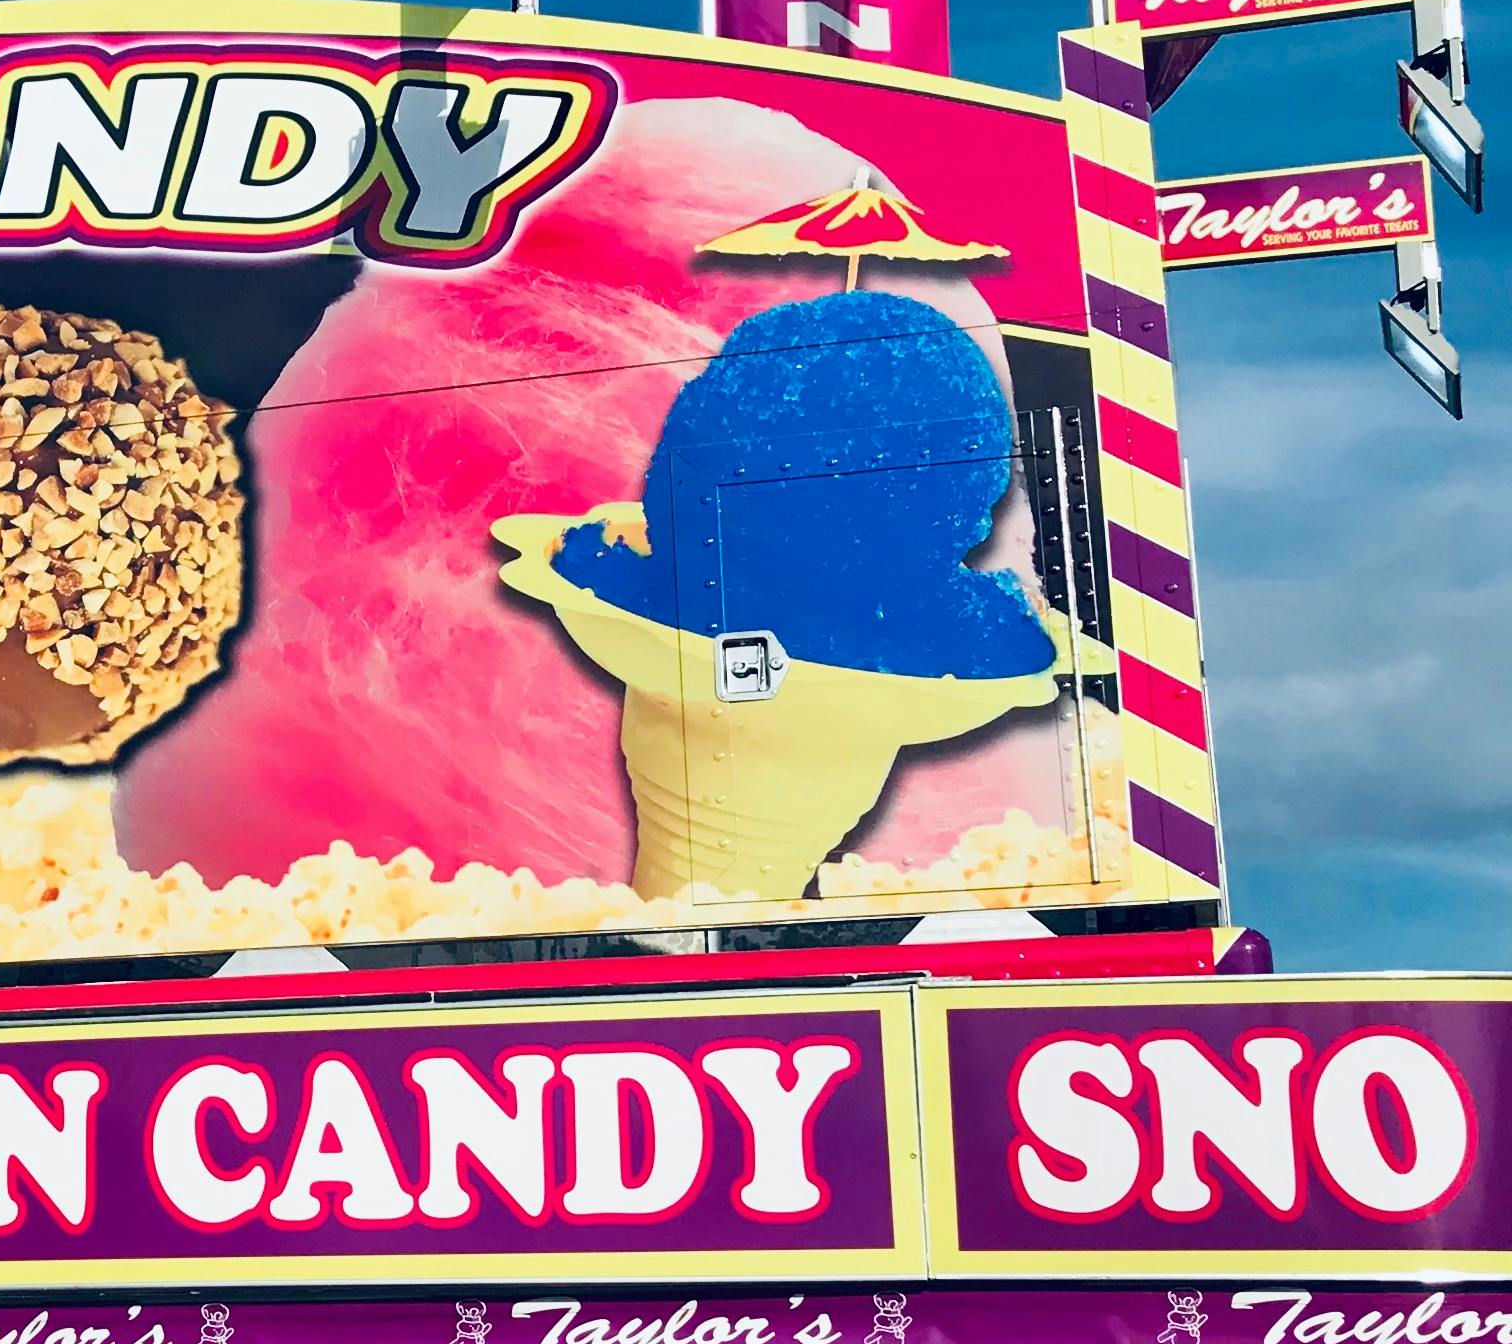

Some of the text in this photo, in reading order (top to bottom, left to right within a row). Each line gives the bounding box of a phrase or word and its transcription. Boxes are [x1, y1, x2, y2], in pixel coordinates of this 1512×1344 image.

[1156, 172, 1415, 247] Taylor's
[1262, 219, 1419, 246] SERVING YOUR FAVORITE TREATS
[150, 1043, 854, 1225] CANDY
[1016, 1033, 1468, 1215] SNO
